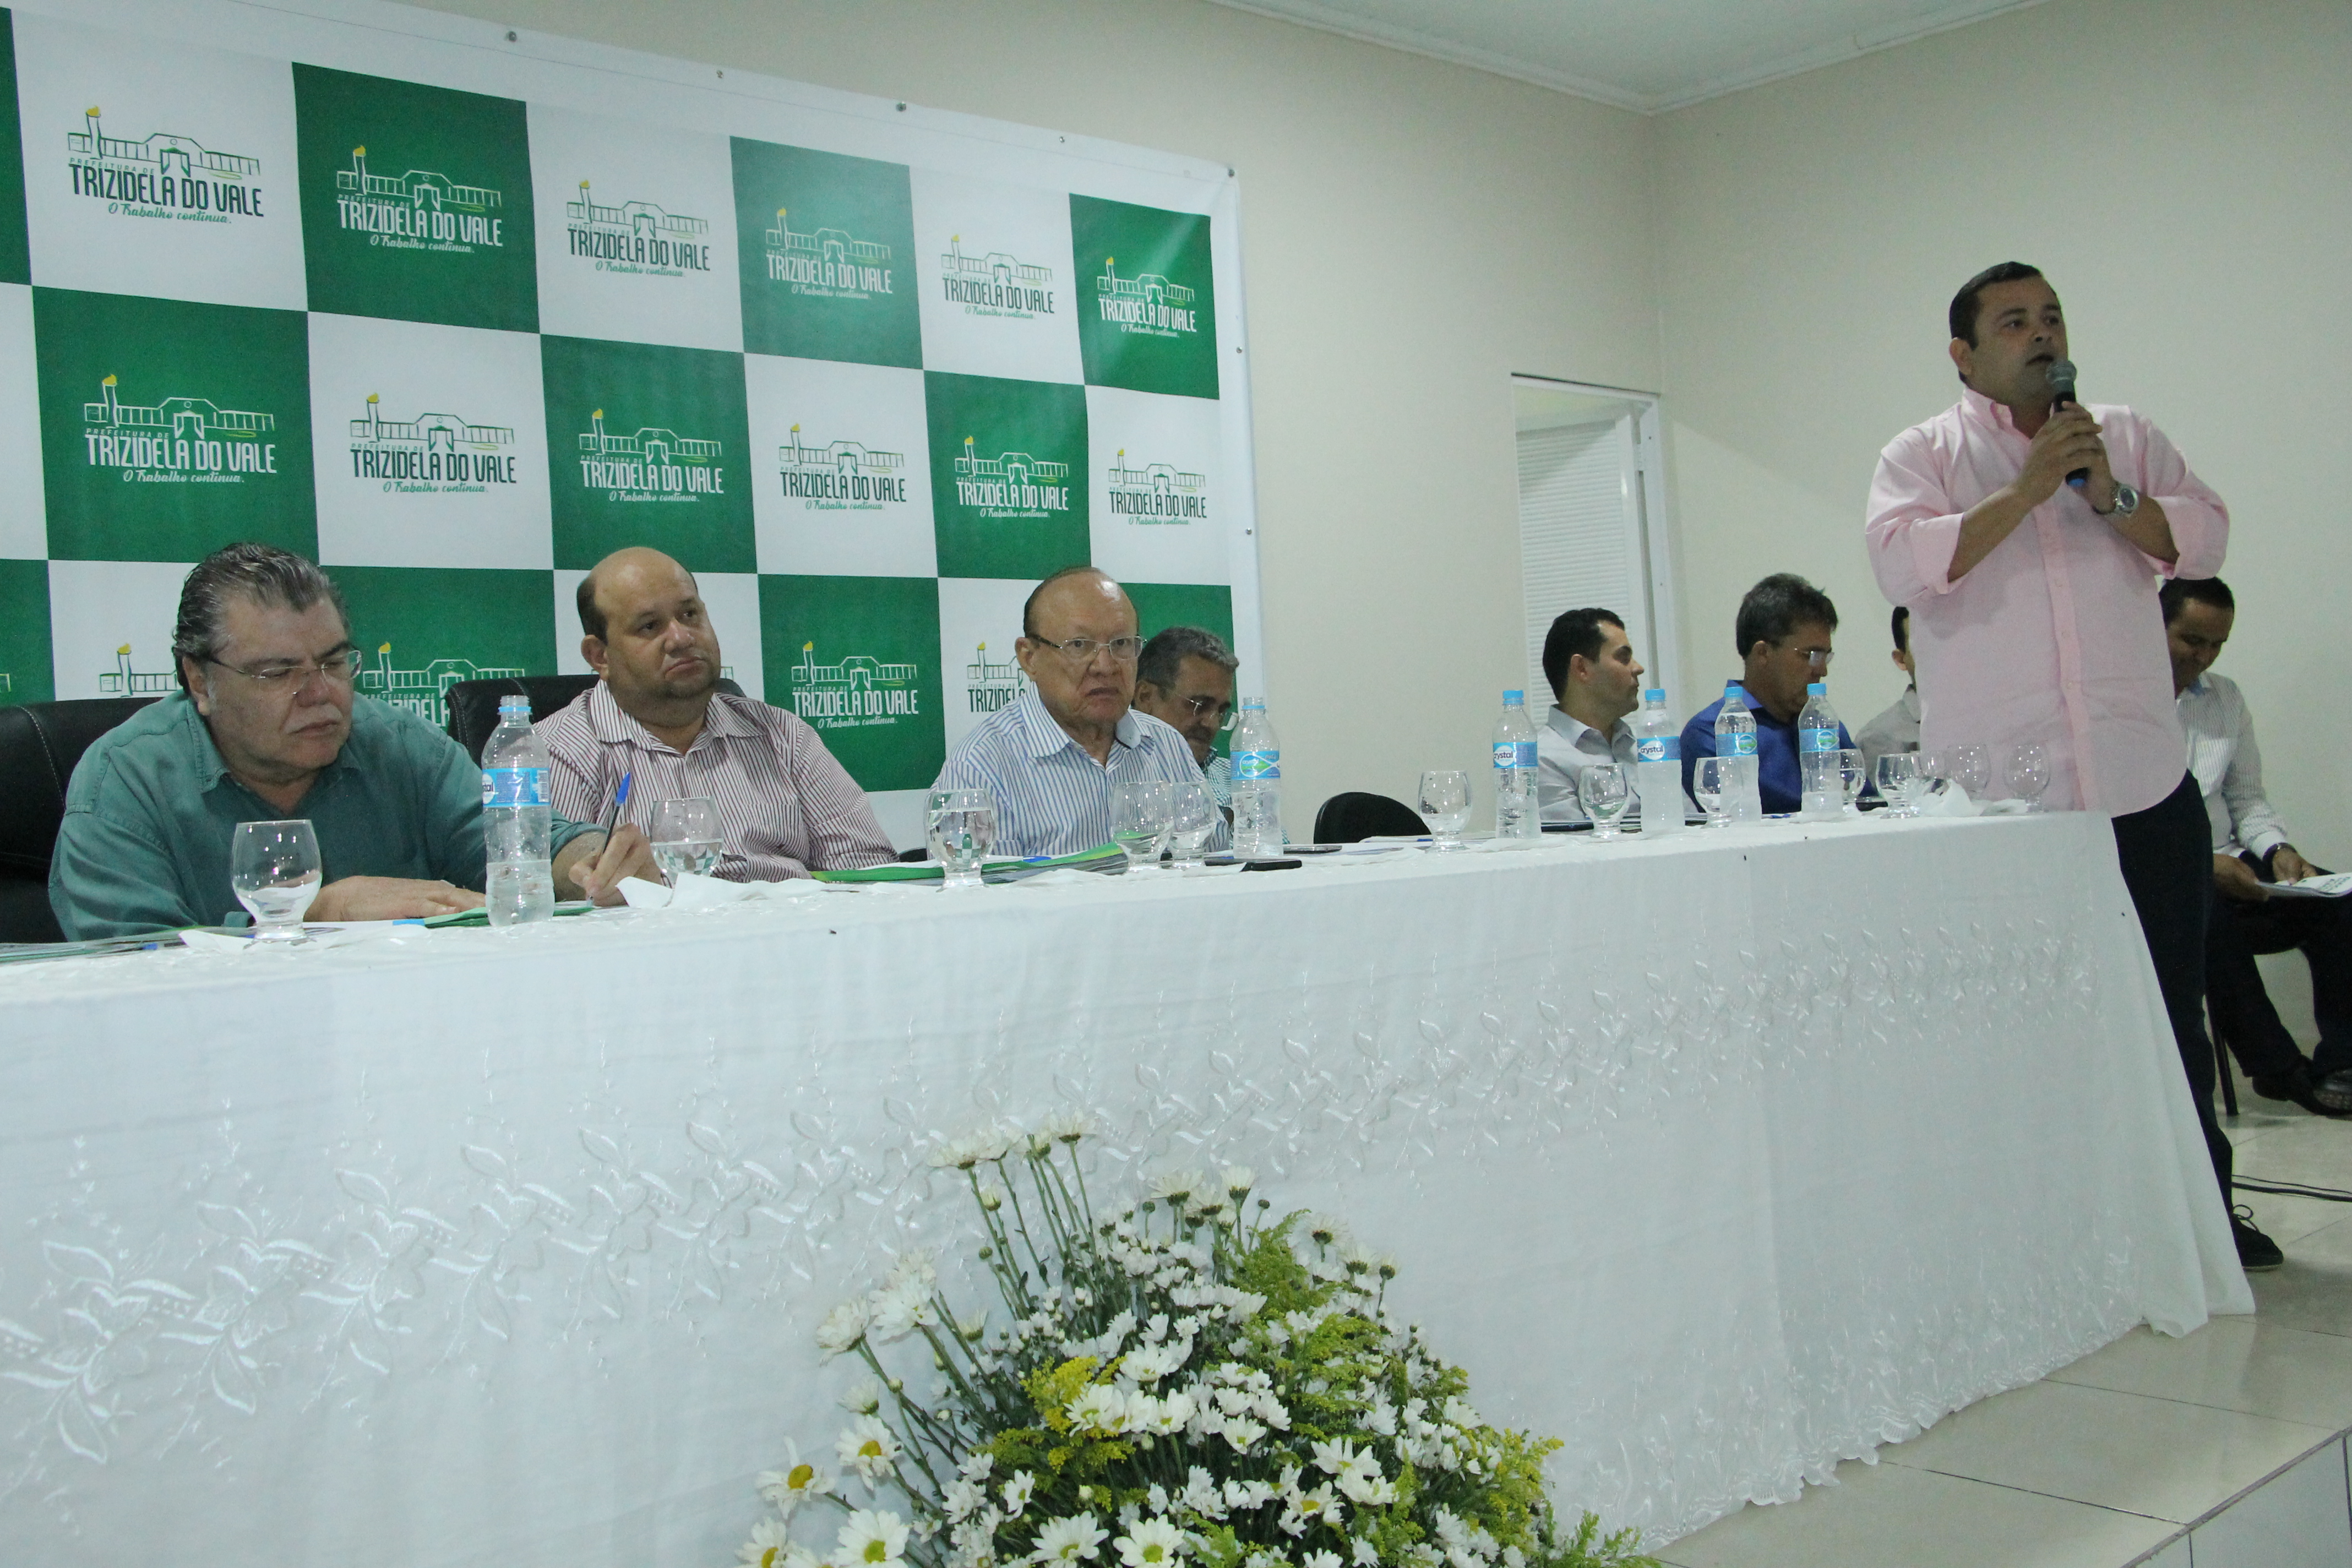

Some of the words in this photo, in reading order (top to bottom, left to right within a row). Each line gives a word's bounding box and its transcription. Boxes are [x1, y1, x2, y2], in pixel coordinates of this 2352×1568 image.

[69, 157, 137, 172] PREFEITURA
[68, 163, 177, 207] TRIZIDELA
[180, 178, 209, 211] DO
[213, 183, 265, 217] VALE
[107, 202, 118, 214] O
[120, 203, 174, 219] Trabalho
[337, 199, 428, 238] TRIZIDELA
[431, 211, 455, 241] DO
[459, 215, 503, 247] VALE
[369, 234, 378, 246] O
[380, 235, 426, 249] Trabalho
[567, 228, 646, 264] TRIZIDELA
[648, 238, 669, 266] DO
[672, 242, 711, 271] VALE
[595, 260, 603, 271] O
[605, 261, 644, 274] Trabalho
[766, 254, 836, 287] TRIZIDELA
[837, 263, 856, 289] DO
[858, 266, 893, 294] VALE
[791, 284, 798, 293] O
[799, 284, 834, 297] Trabalho
[942, 277, 1004, 308] TRIZIDELA
[1005, 286, 1022, 310] DO
[1024, 288, 1055, 314] VALE
[965, 304, 971, 314] O
[972, 306, 1003, 317] Trabalho
[1098, 298, 1156, 326] TRIZIDELA
[1158, 304, 1169, 328] DO
[1171, 307, 1197, 333] VALE
[1120, 323, 1127, 332] O
[1128, 324, 1155, 334] Trabalho
[85, 428, 151, 437] PREFEITURA
[85, 434, 190, 470] TRIZIDELA
[194, 440, 222, 471] DO
[226, 442, 277, 473] VALE
[351, 443, 409, 451] PREFEITURA
[350, 448, 442, 481] TRIZIDELA
[445, 453, 470, 482] DO
[473, 455, 517, 483] VALE
[123, 469, 133, 482] O
[135, 470, 188, 482] Trabalho
[580, 460, 659, 491] TRIZIDELA
[661, 465, 683, 492] DO
[685, 466, 724, 493] VALE
[383, 481, 391, 493] O
[394, 481, 439, 493] Trabalho
[780, 471, 850, 499] TRIZIDELA
[851, 476, 870, 500] DO
[872, 477, 907, 502] VALE
[609, 491, 617, 501] O
[618, 491, 657, 501] Trabalho
[955, 481, 1020, 508] TRIZIDELA
[1021, 485, 1038, 508] DO
[1039, 486, 1069, 509] VALE
[805, 499, 812, 510] O
[813, 500, 847, 510] Trabalho
[1108, 491, 1163, 516] TRIZIDELA
[1164, 494, 1179, 516] DO
[1181, 496, 1207, 518] VALE
[979, 508, 986, 518] O
[987, 508, 1018, 517] Trabalho
[1128, 516, 1134, 525] O
[1135, 516, 1162, 525] Trabalho
[792, 690, 862, 717] TRIZIDELA
[863, 690, 883, 715] DO
[885, 690, 919, 715] VALE
[818, 718, 824, 728] O
[825, 717, 860, 728] Trabalho
[1640, 745, 1663, 754] crystal
